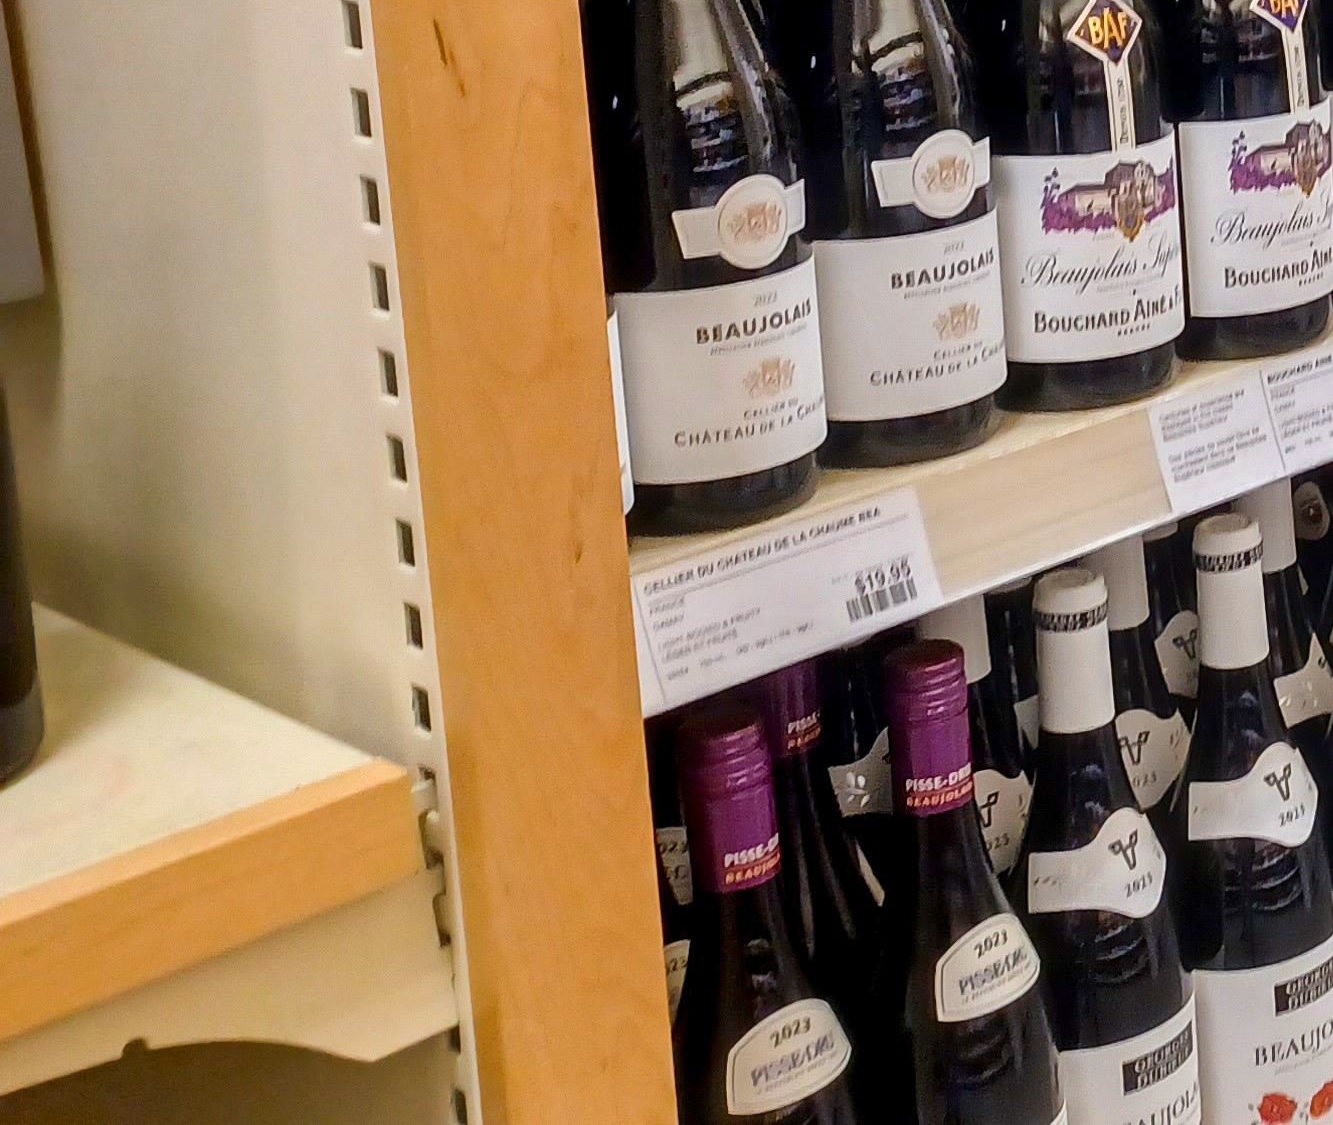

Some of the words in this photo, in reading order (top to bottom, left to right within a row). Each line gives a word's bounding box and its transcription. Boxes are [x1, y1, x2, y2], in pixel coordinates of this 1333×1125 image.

[1210, 205, 1314, 249] Beaujolais
[891, 247, 995, 291] BEAUJOLAIS
[1021, 250, 1139, 294] Beaujolais
[1223, 261, 1309, 289] BOUCHARD
[696, 297, 812, 345] BEAUJOLAIS
[1034, 307, 1130, 334] BOUCHARD
[870, 362, 946, 388] CHÂTEAU
[674, 421, 755, 448] CHÂTEAU
[696, 563, 714, 579] DU
[974, 929, 1008, 959] 2023
[769, 1017, 811, 1049] 2023
